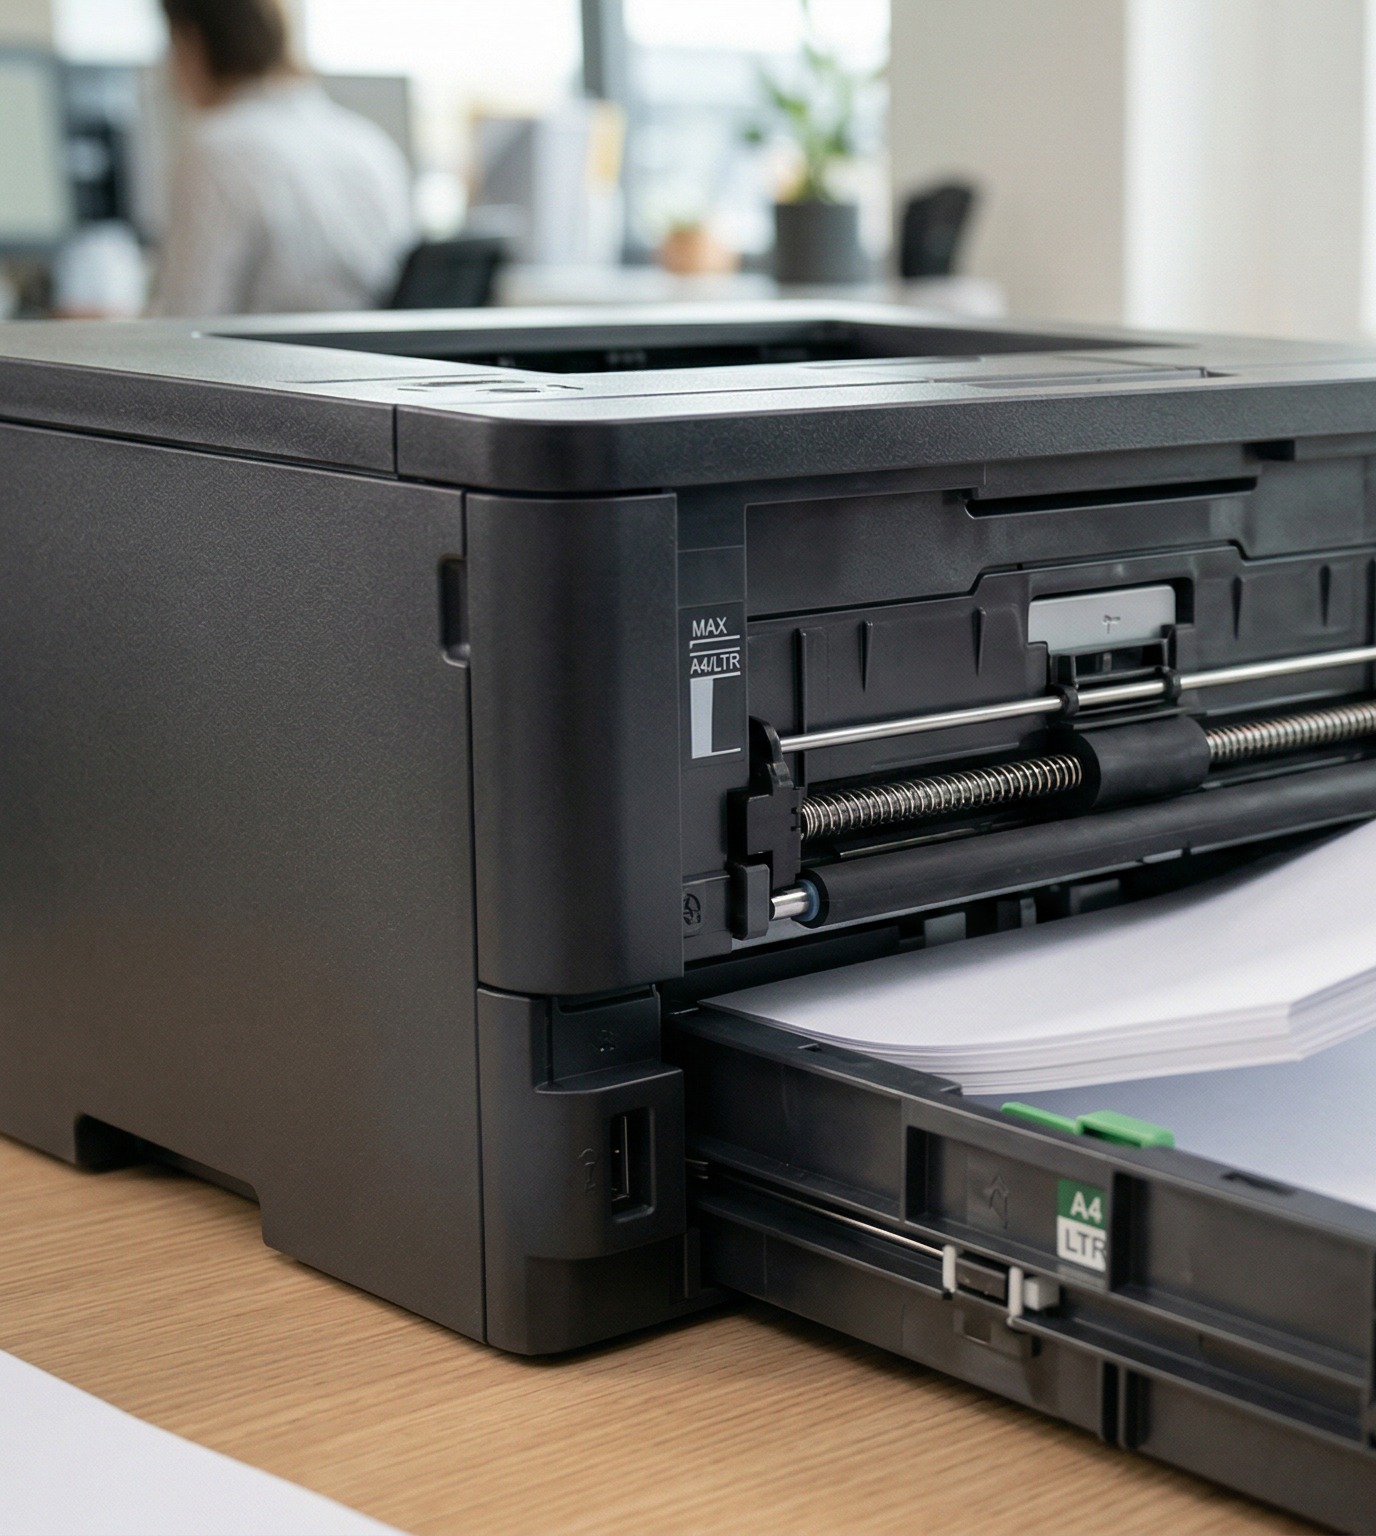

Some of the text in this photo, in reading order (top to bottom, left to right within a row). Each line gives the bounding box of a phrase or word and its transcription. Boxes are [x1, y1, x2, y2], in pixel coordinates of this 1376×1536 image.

[692, 617, 727, 637] MAX
[690, 653, 740, 674] A4/LTR
[1070, 1191, 1102, 1223] A4
